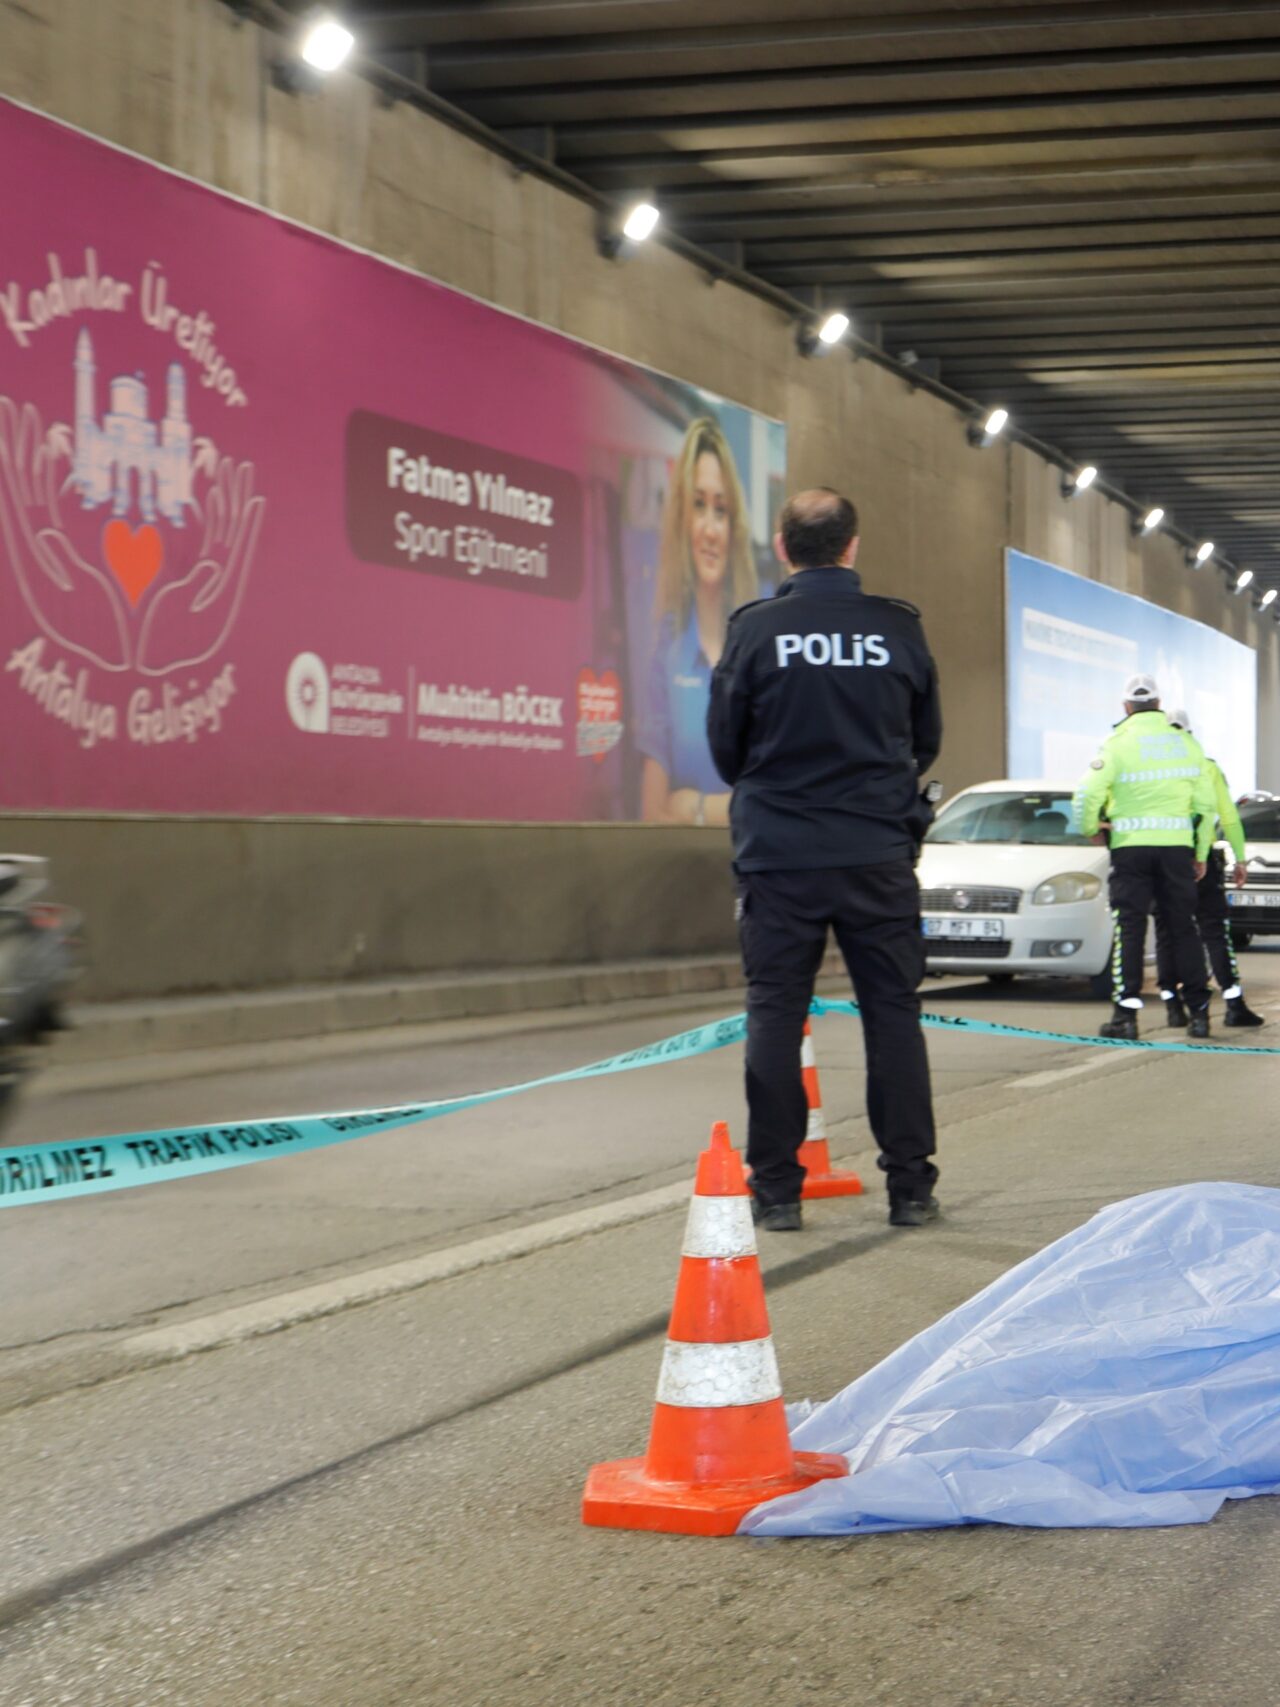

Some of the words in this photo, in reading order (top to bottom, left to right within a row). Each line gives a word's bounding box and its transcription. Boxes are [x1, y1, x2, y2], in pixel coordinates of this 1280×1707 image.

[141, 260, 247, 406] Üretiyor
[387, 447, 471, 506] Fatma
[473, 470, 554, 527] Yılmaz
[394, 511, 452, 562] Spor
[454, 525, 548, 579] Eğitmeni
[5, 637, 117, 748] Antalya
[127, 662, 236, 743] Gelişiyor
